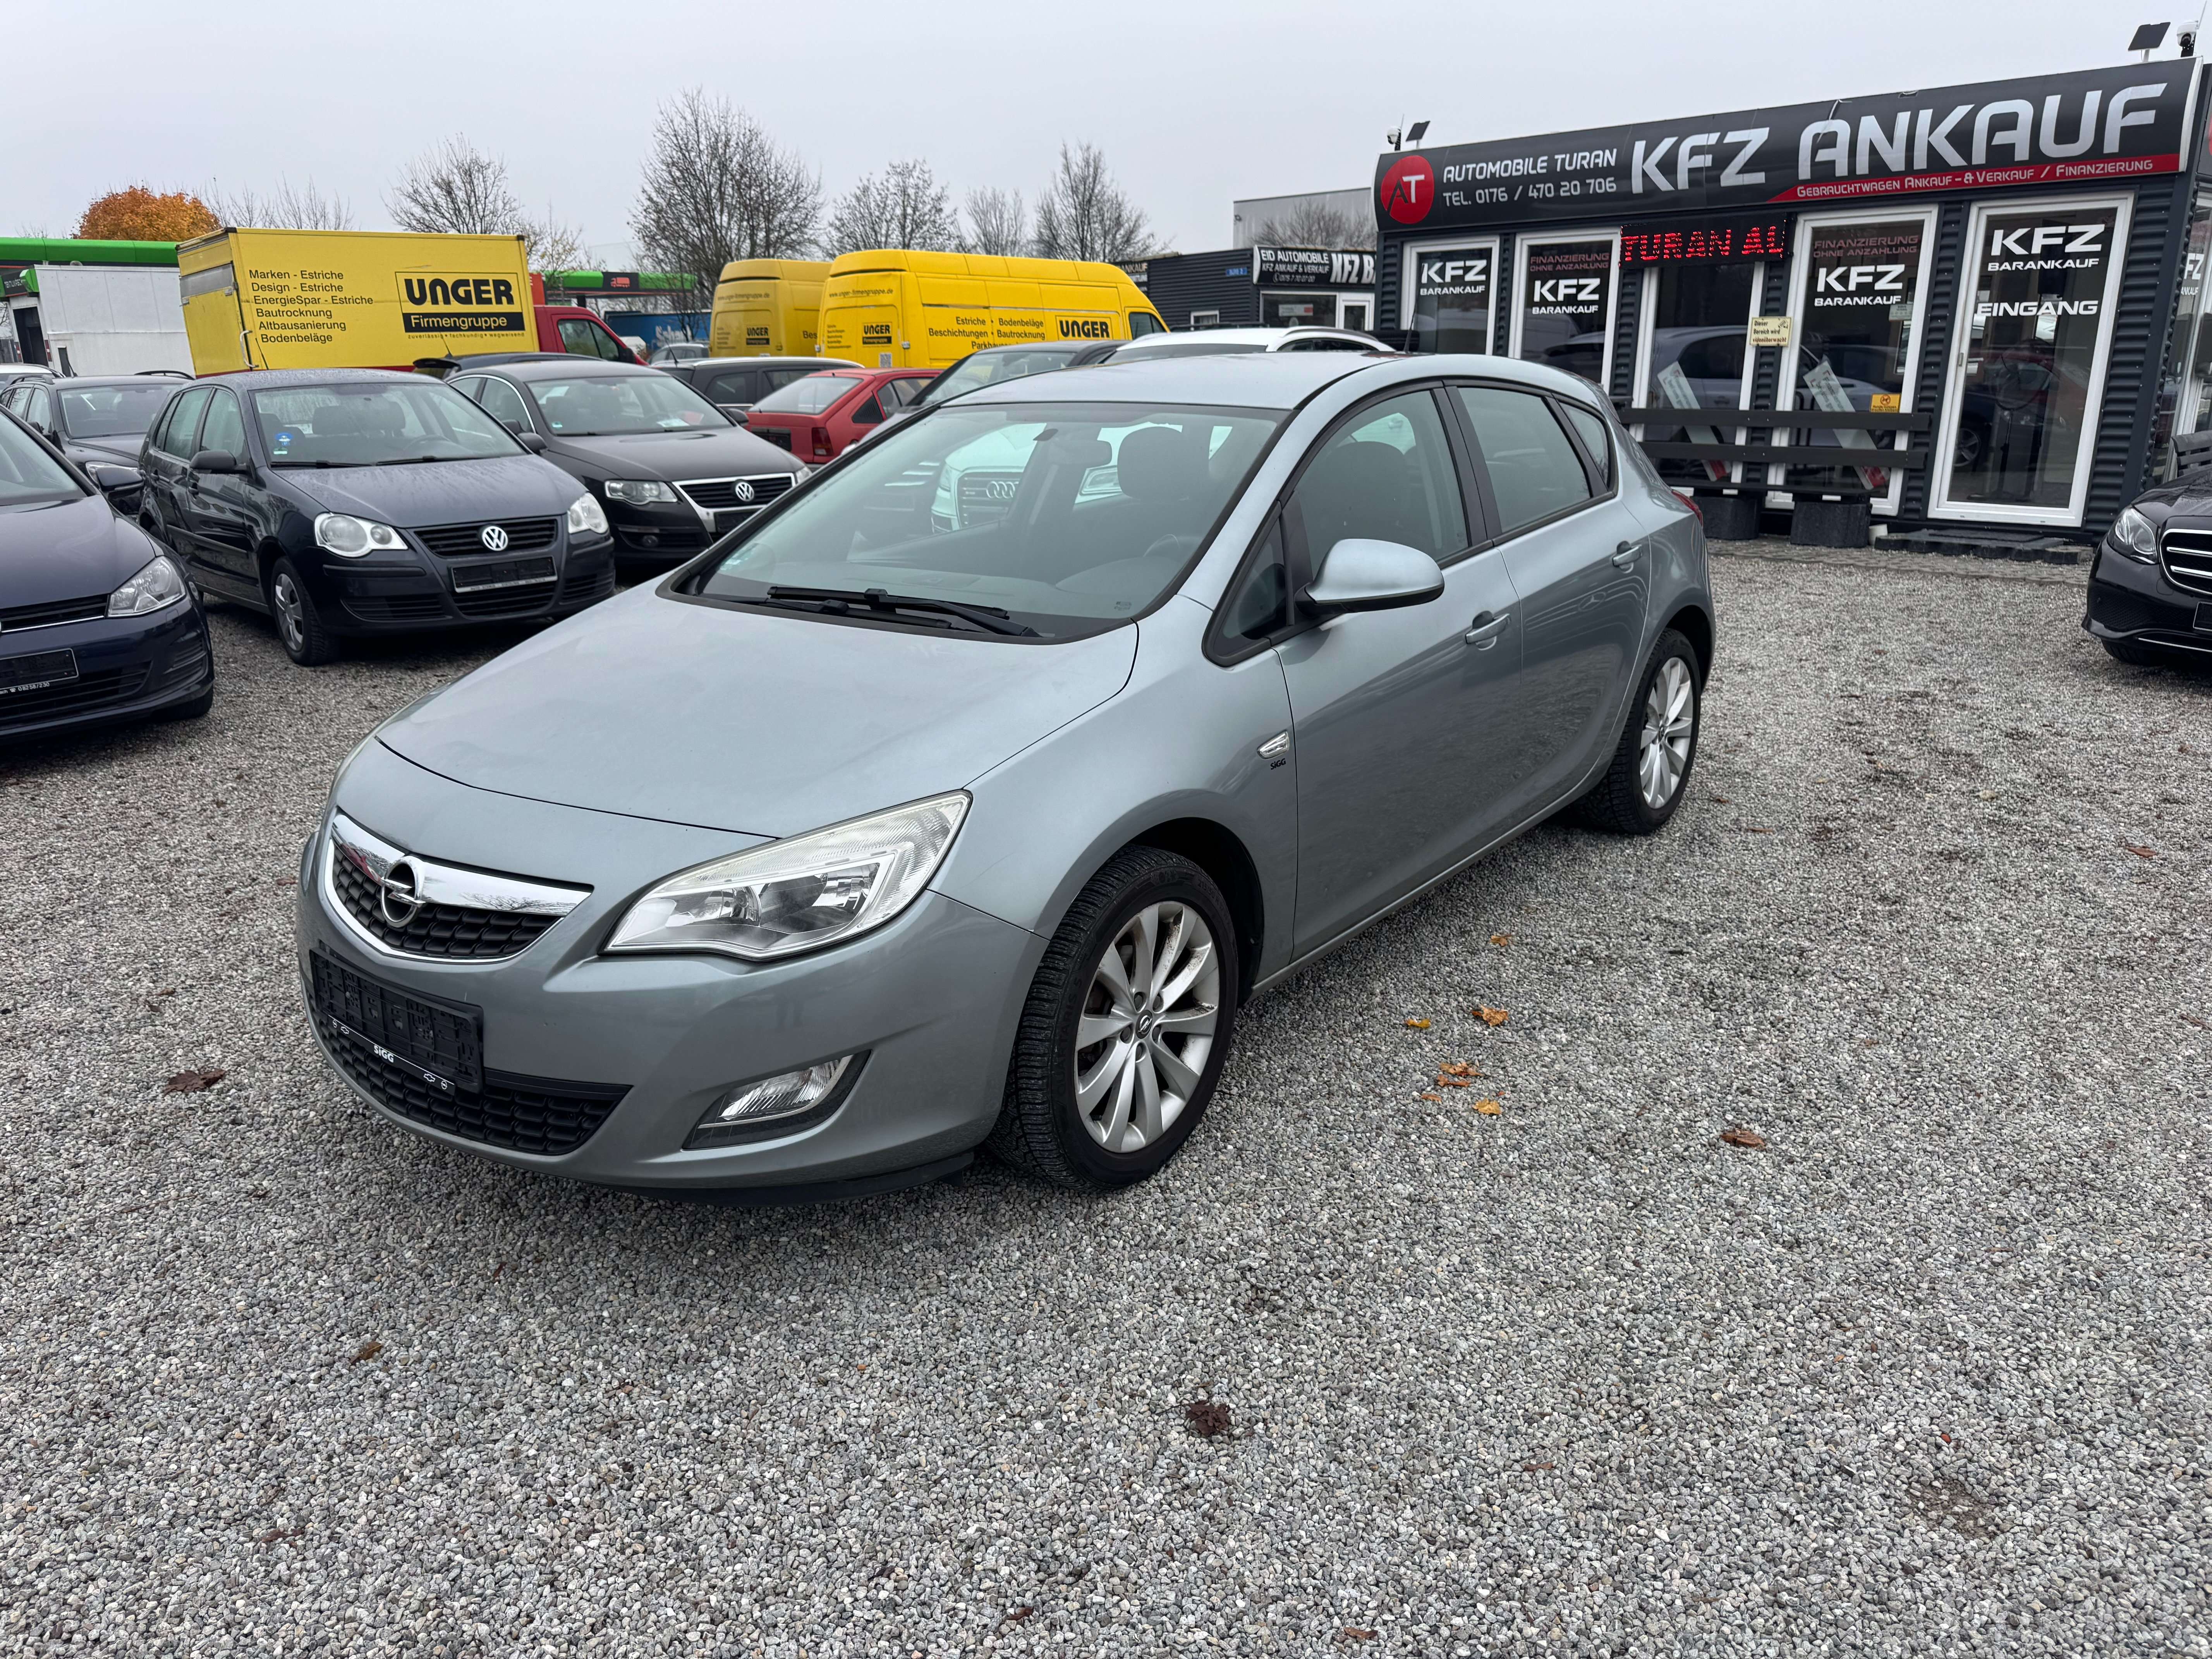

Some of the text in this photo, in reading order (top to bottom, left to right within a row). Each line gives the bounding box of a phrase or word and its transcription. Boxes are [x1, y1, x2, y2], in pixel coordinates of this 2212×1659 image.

[1631, 82, 2168, 193] KFZ ANKAUF
[1443, 148, 1617, 183] AUTOMOBILE TURAN
[1443, 191, 1472, 207] TEL.
[1476, 187, 1508, 204] 0176
[1528, 183, 1554, 199] 470
[1560, 180, 1580, 196] 20
[1585, 176, 1617, 194] 706
[1621, 229, 1731, 261] TURAN
[1814, 235, 1919, 249] FINANZIERUNG
[1991, 223, 2105, 256] KFZ
[1261, 250, 1329, 264] EID AUTOMOBILE
[1530, 252, 1610, 264] FINANZIERUNG
[1814, 246, 1917, 258] OHNE ANZAHLUNG
[1274, 263, 1298, 273] ANKAUF
[1330, 253, 1377, 285] KFZ B
[1421, 259, 1487, 283] KFZ
[1555, 262, 1609, 270] ANZAHLUNG
[1987, 258, 2099, 271] BARANKAUF
[249, 269, 290, 279] Marken
[300, 270, 344, 280] Estriche
[1817, 264, 1905, 292] KFZ
[251, 282, 290, 294] Design
[300, 283, 343, 292] Estriche
[404, 278, 514, 306] UNGER
[1420, 285, 1486, 295] BARANKAUF
[1534, 278, 1601, 302] KFZ
[254, 295, 321, 306] EnergieSpar
[331, 295, 374, 305] Estriche
[1814, 295, 1901, 307] BARANKAUF
[256, 308, 332, 319] Bautrocknung
[1532, 305, 1599, 314] BARANKAUF
[1977, 300, 2099, 317] EINGANG
[259, 321, 346, 331] Altbausanierung
[410, 315, 507, 330] Firmengruppe
[956, 316, 1044, 328] Estriche Bodenbeläge
[747, 327, 769, 337] UNGER
[864, 325, 890, 335] UNGER
[929, 328, 1045, 341] Beschichtungen Bautrocknung
[1059, 320, 1110, 338] UNGER
[261, 333, 333, 344] Bodenbeläge
